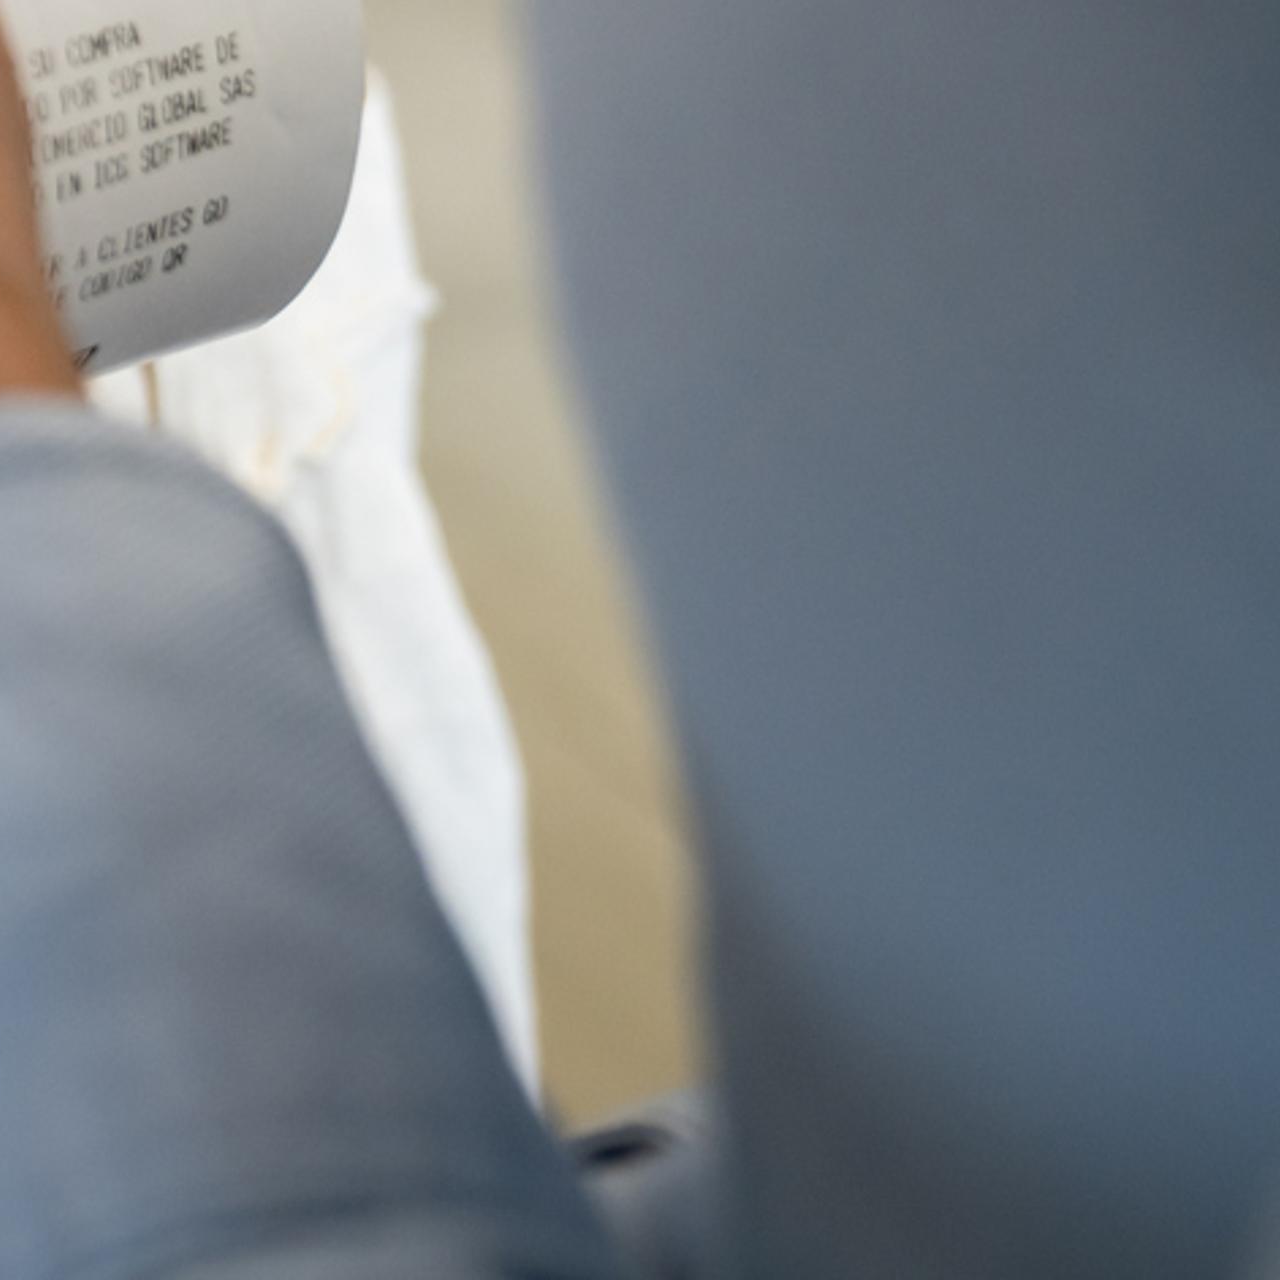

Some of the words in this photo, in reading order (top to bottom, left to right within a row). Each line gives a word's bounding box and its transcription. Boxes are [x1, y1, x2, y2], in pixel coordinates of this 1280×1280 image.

[64, 21, 142, 67] COMPRA
[108, 43, 206, 98] SOFTWARE
[215, 32, 240, 63] DE
[138, 89, 207, 132] GLOBAL
[220, 70, 257, 105] SAS
[139, 117, 234, 174] SOFTWARE
[97, 206, 196, 261] CLIENTES
